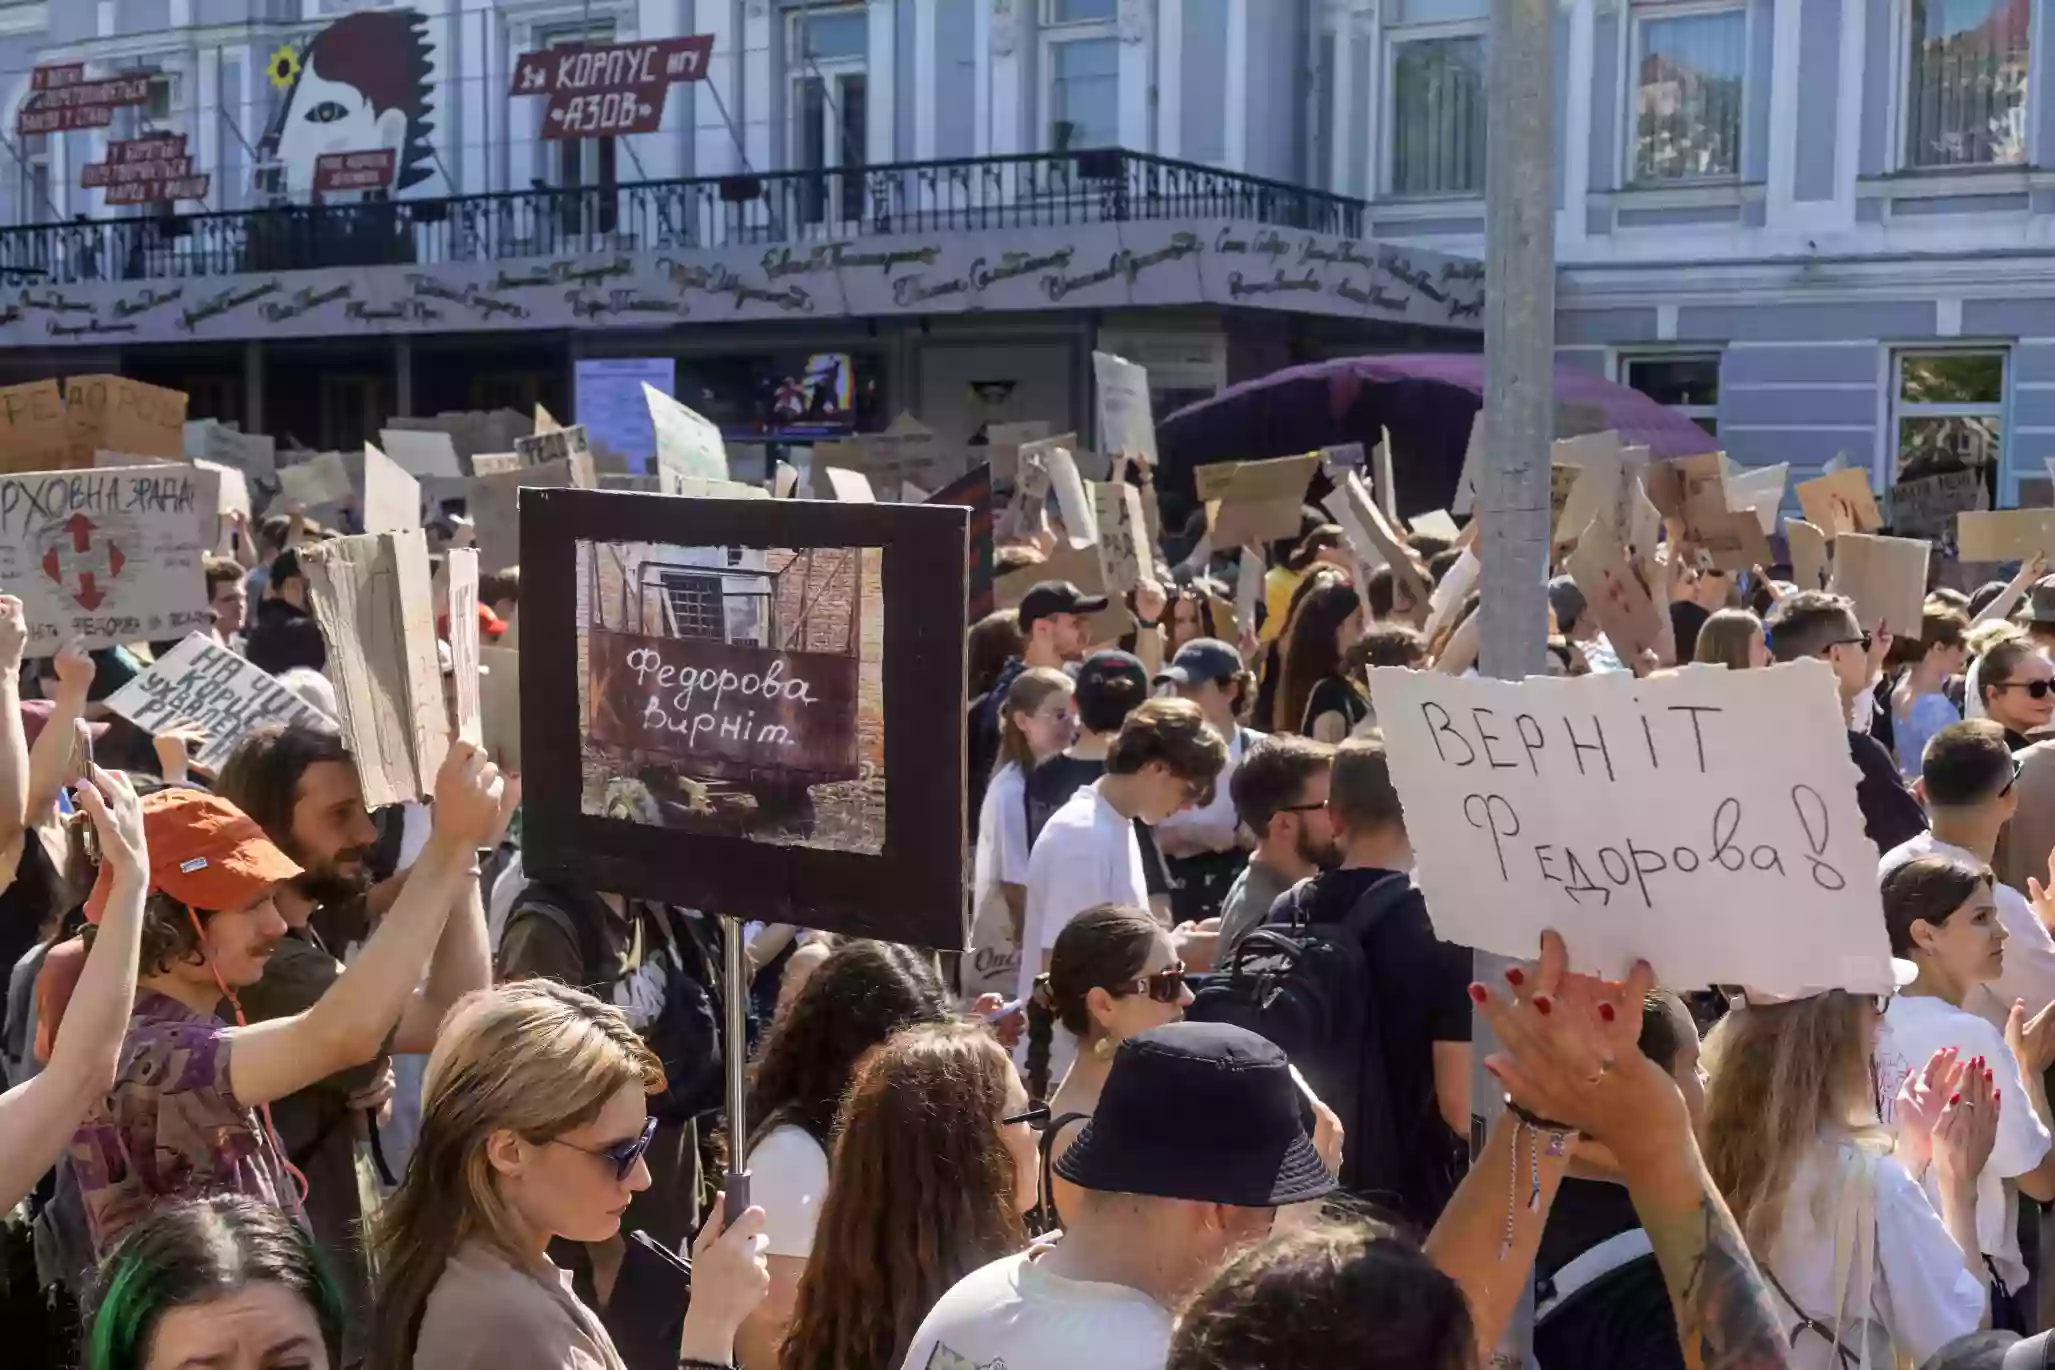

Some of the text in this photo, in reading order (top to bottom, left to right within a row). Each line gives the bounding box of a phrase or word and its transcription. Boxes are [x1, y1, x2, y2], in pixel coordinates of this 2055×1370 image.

[556, 46, 658, 90] КОРПУС
[189, 645, 245, 683] НА
[626, 647, 820, 712] Федорова
